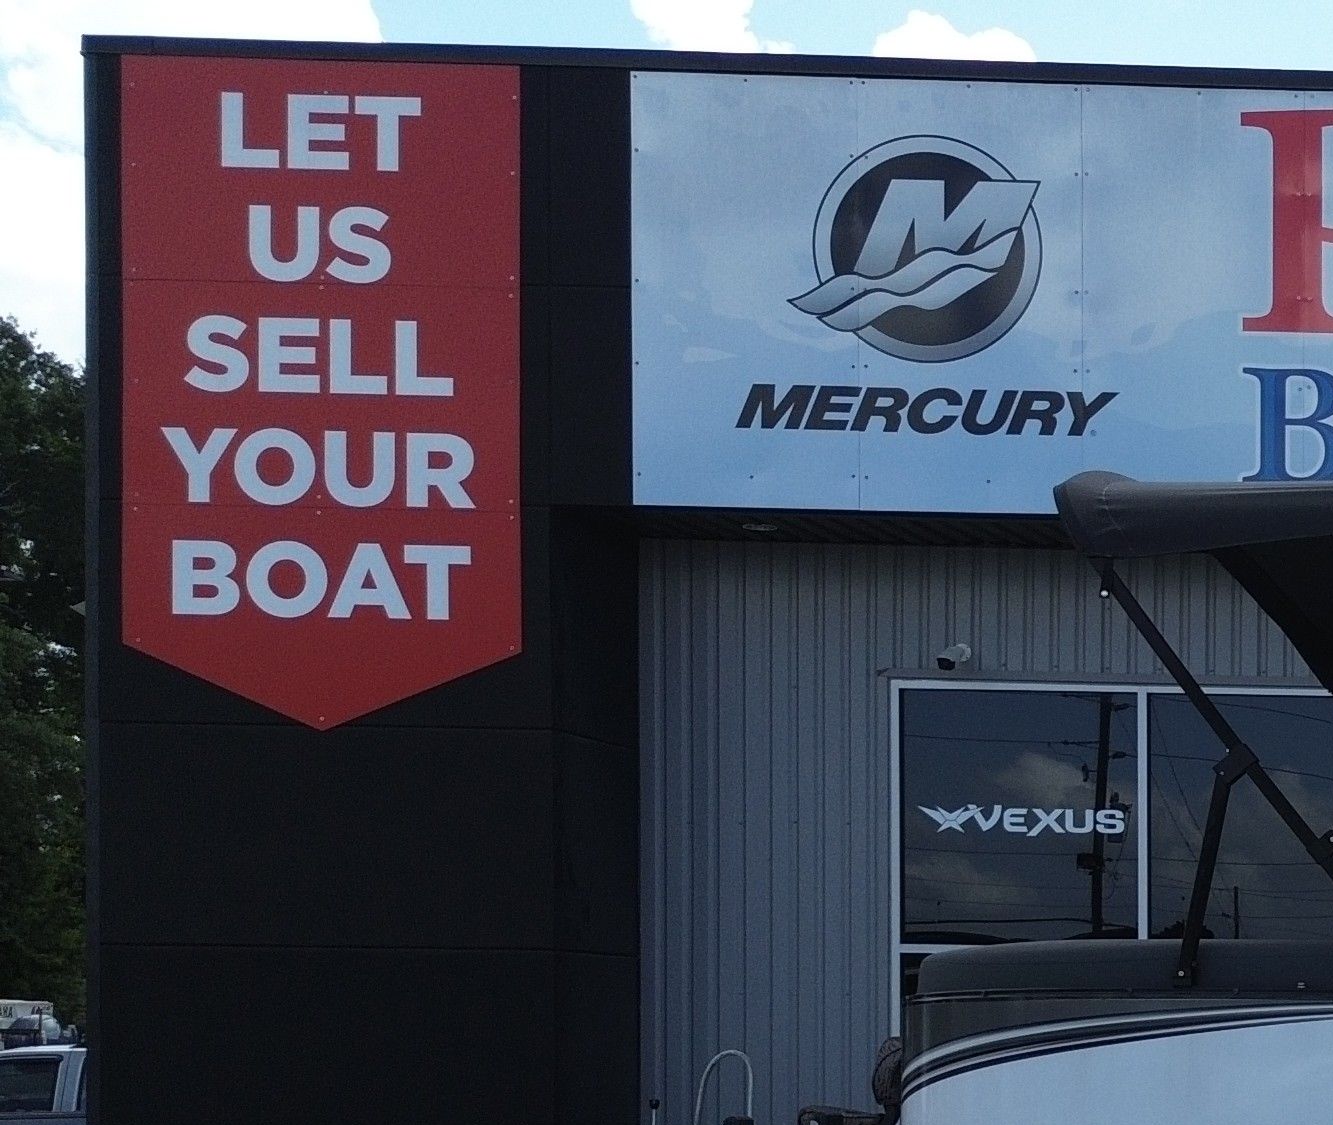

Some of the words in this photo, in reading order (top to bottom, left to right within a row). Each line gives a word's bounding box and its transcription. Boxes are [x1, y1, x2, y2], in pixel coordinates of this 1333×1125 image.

[220, 91, 422, 172] LET
[248, 204, 392, 285] US
[183, 315, 455, 397] SELL
[735, 383, 1119, 437] MERCURY
[160, 426, 477, 510] YOUR
[171, 539, 472, 621] BOAT
[967, 804, 1126, 837] VEXUS
